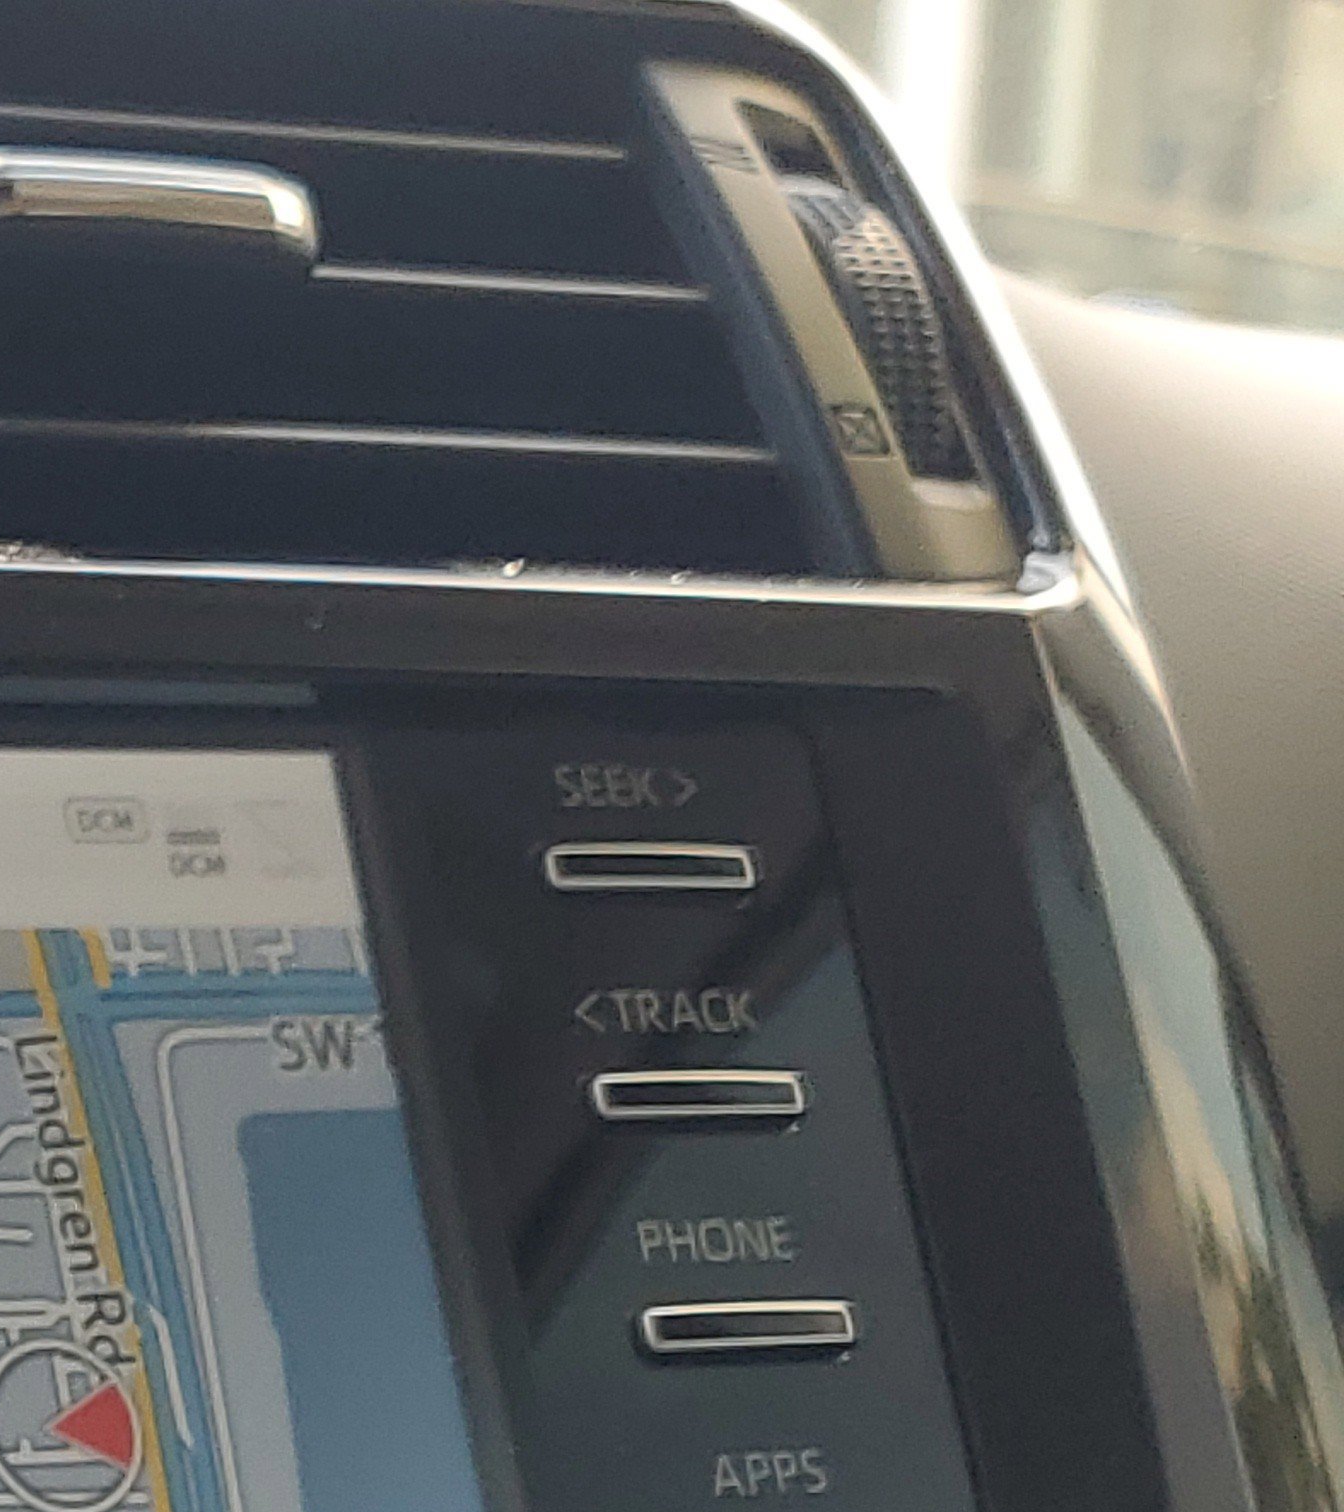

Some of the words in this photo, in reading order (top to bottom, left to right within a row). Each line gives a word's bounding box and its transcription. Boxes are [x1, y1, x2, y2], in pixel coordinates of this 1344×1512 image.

[553, 763, 660, 808] SEEK
[14, 1034, 100, 1273] Lindgren
[76, 1290, 137, 1366] Rd
[635, 1213, 800, 1264] PHONE
[713, 1448, 829, 1498] APPS
